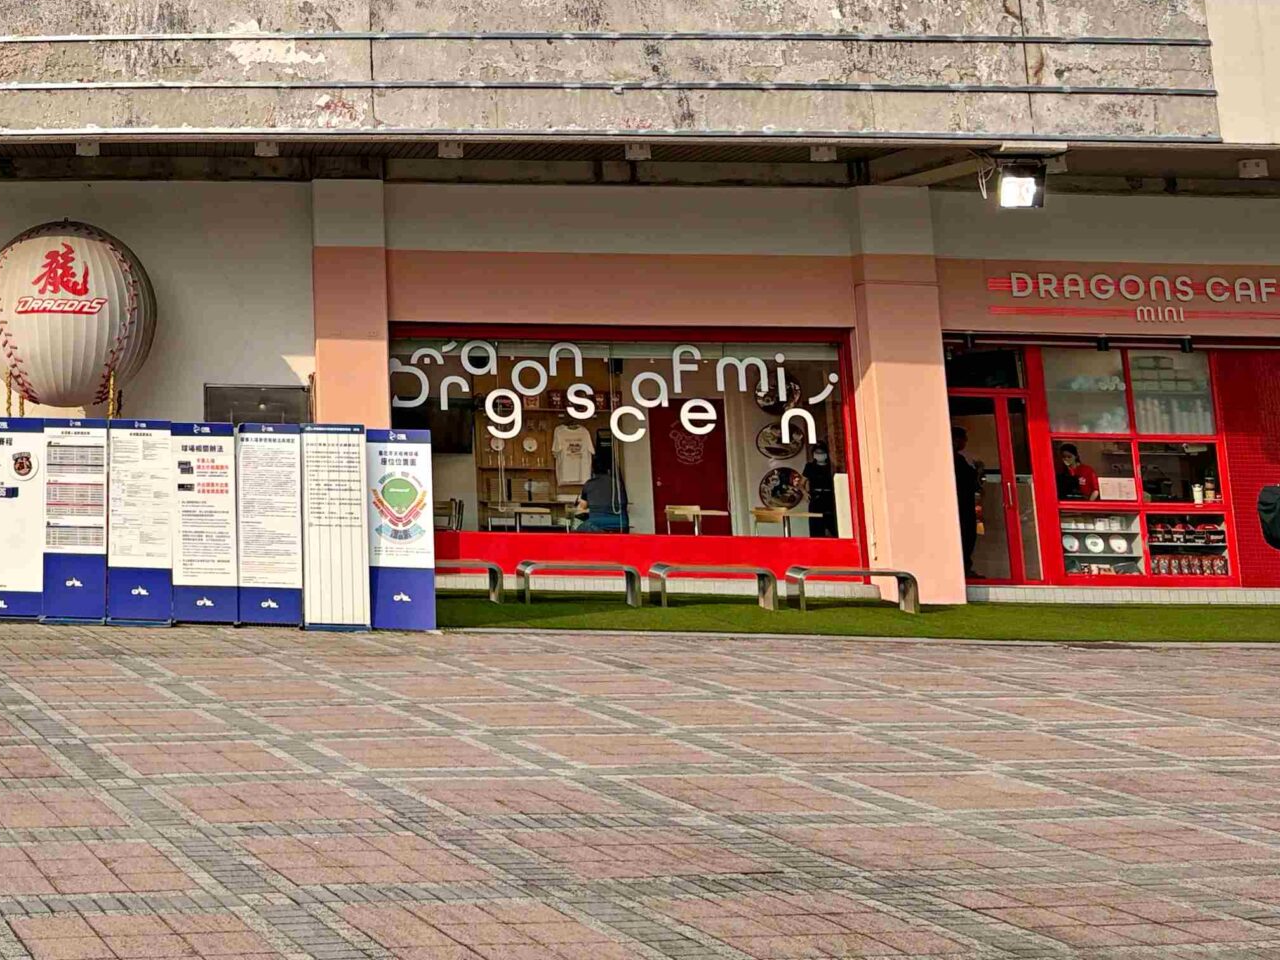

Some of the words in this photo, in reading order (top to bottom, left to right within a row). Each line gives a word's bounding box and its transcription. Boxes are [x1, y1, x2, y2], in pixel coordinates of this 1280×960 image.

[1010, 271, 1195, 302] DRAGONS
[1206, 277, 1279, 303] CAF
[16, 296, 107, 313] DRAGONS
